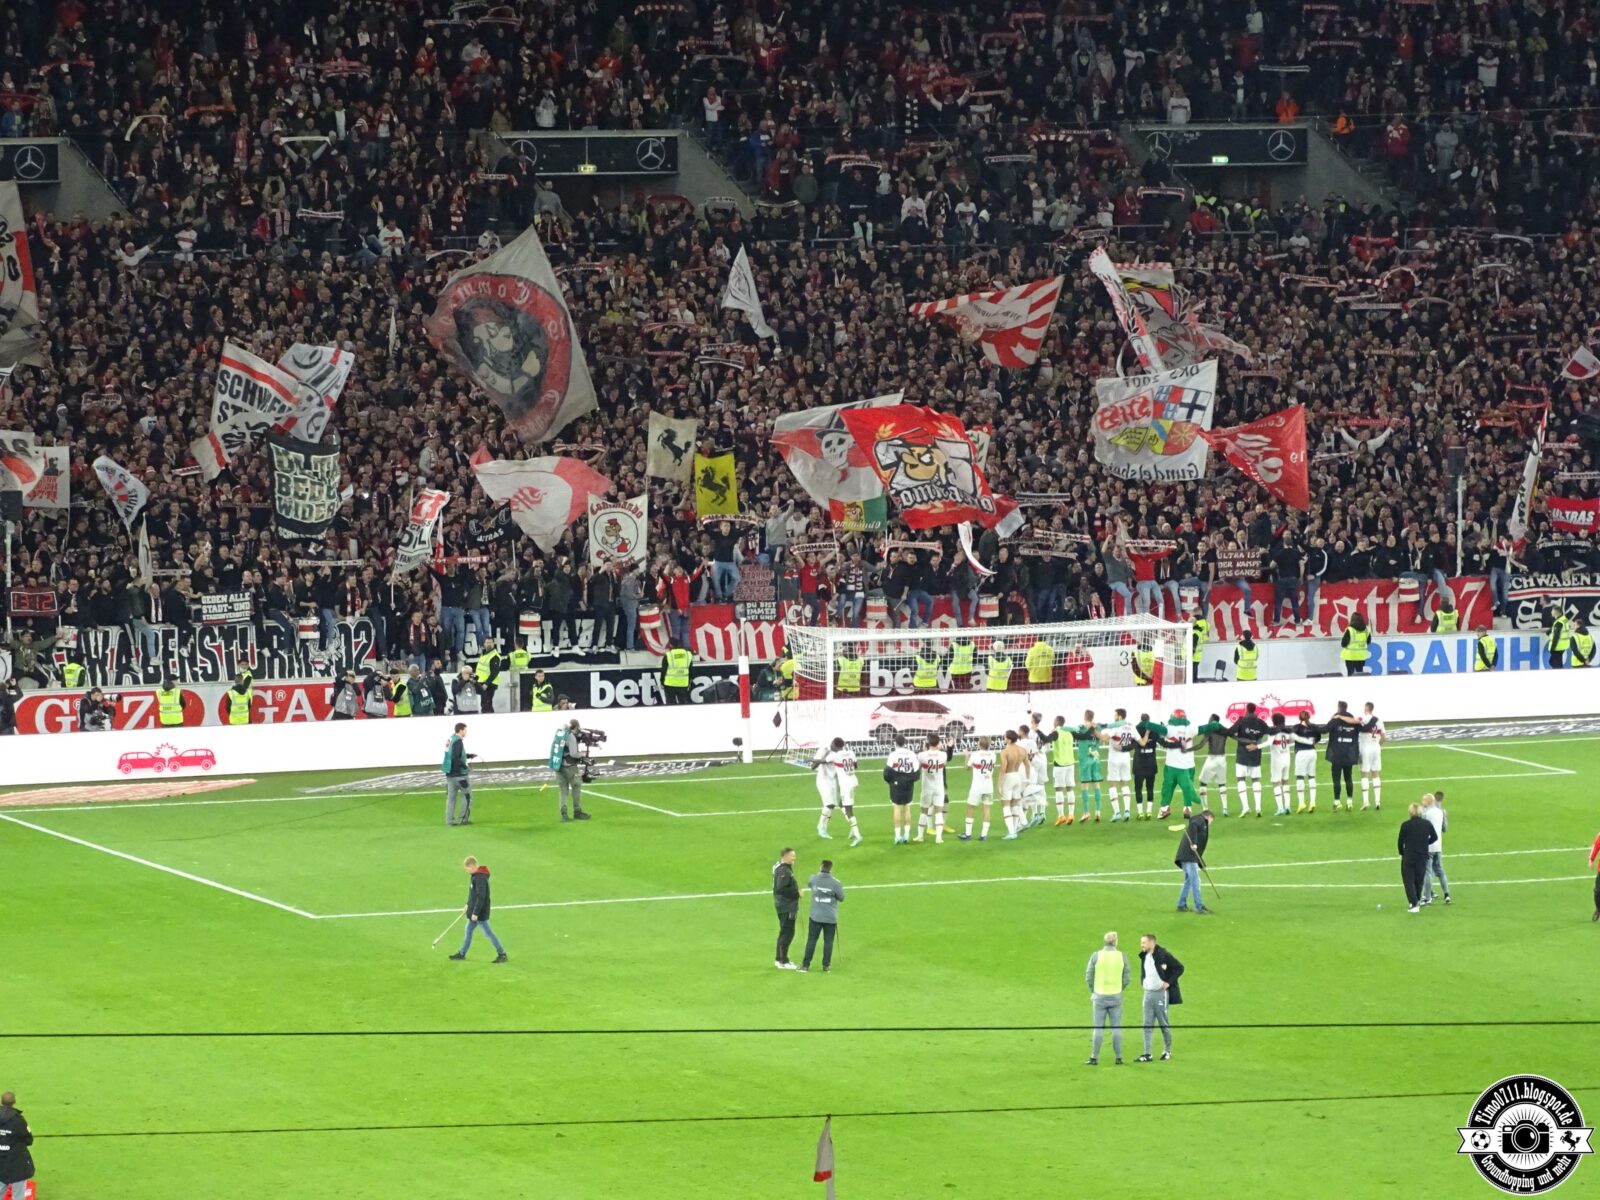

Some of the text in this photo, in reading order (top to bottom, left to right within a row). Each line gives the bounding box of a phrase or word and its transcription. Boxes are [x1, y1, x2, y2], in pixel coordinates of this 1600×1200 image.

[1552, 508, 1596, 525] ULTRAS
[1508, 573, 1591, 589] CHWABEN
[229, 592, 250, 602] ALLE
[202, 602, 250, 614] STADT- UND
[590, 671, 739, 708] beta
